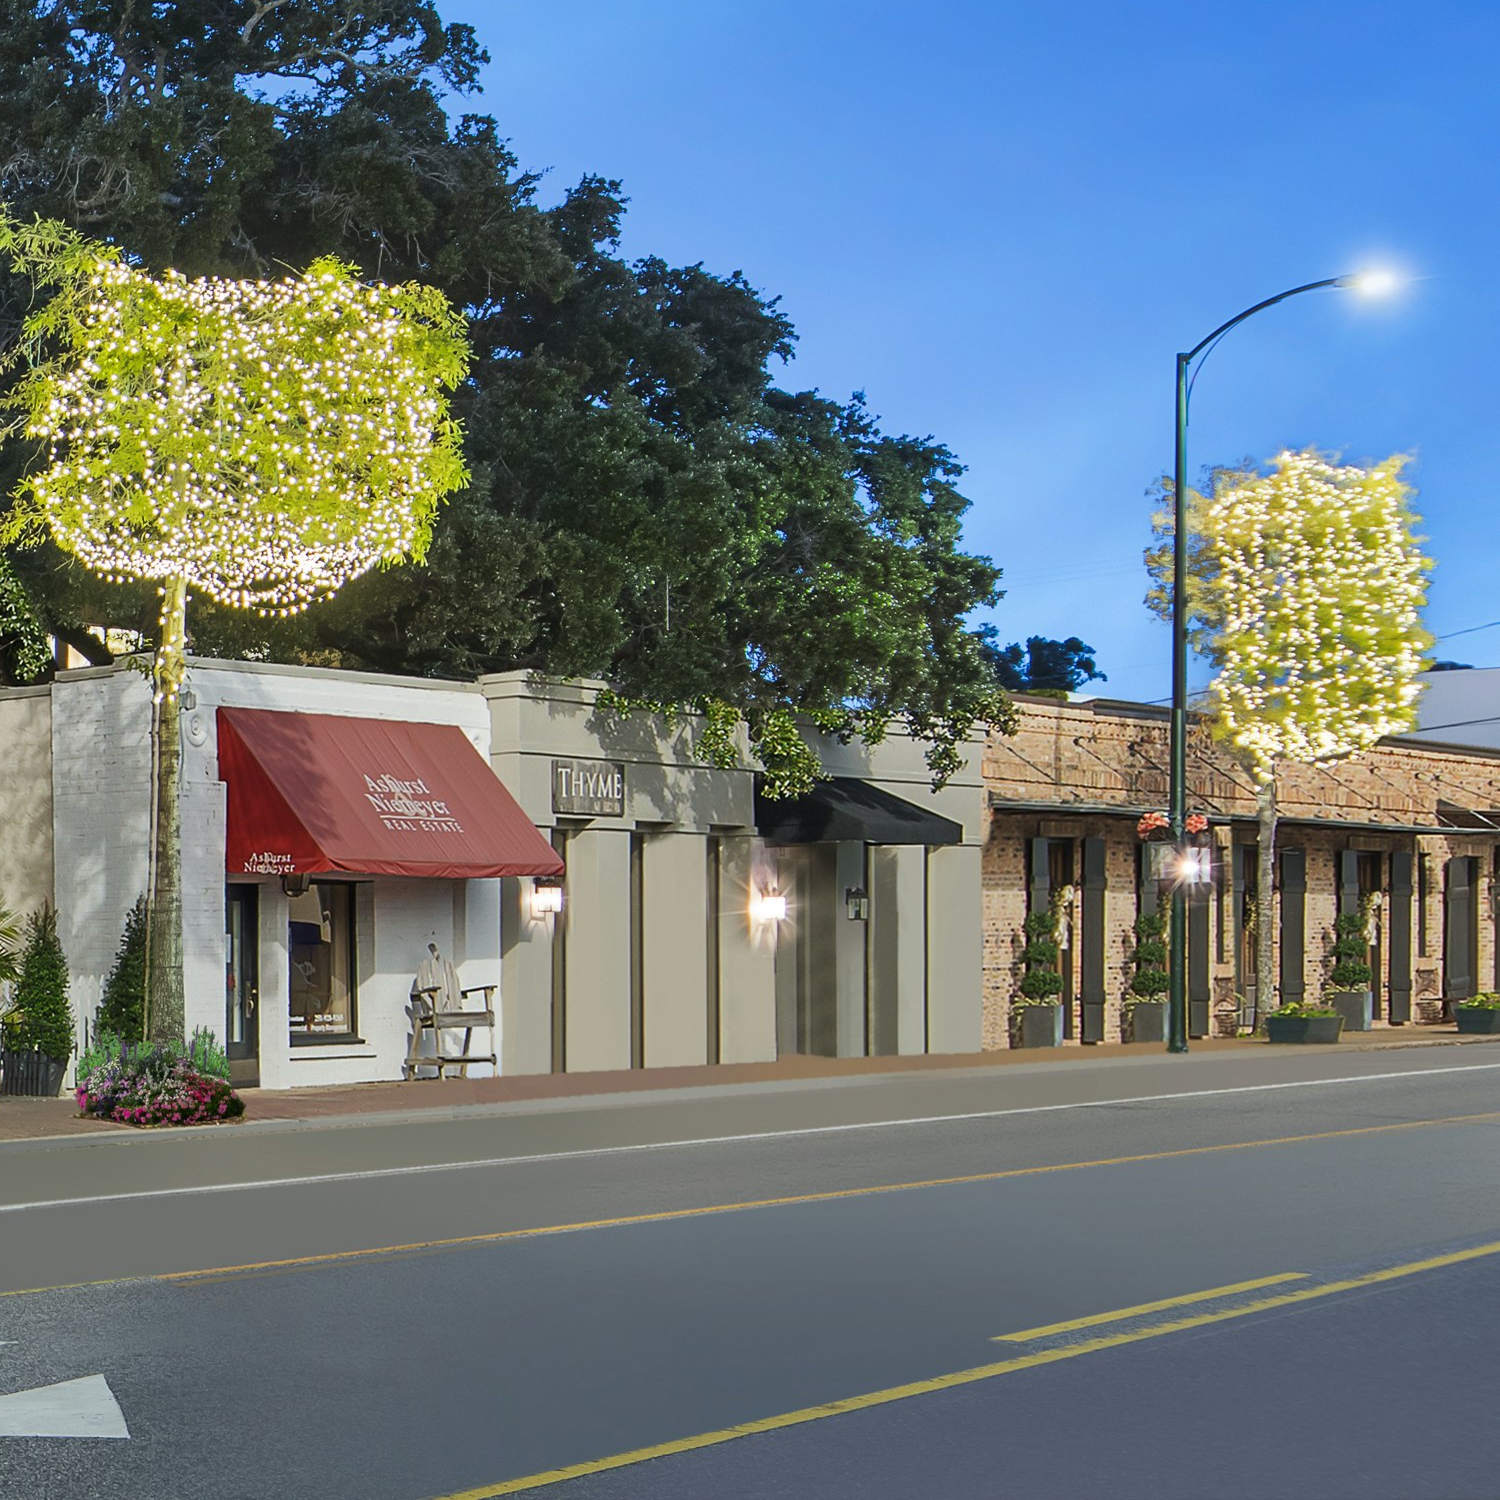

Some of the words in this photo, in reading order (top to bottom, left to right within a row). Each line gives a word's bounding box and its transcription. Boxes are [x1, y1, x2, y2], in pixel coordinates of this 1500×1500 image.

[558, 768, 622, 799] THYME
[383, 819, 418, 831] REAL
[420, 820, 464, 833] ESTATE
